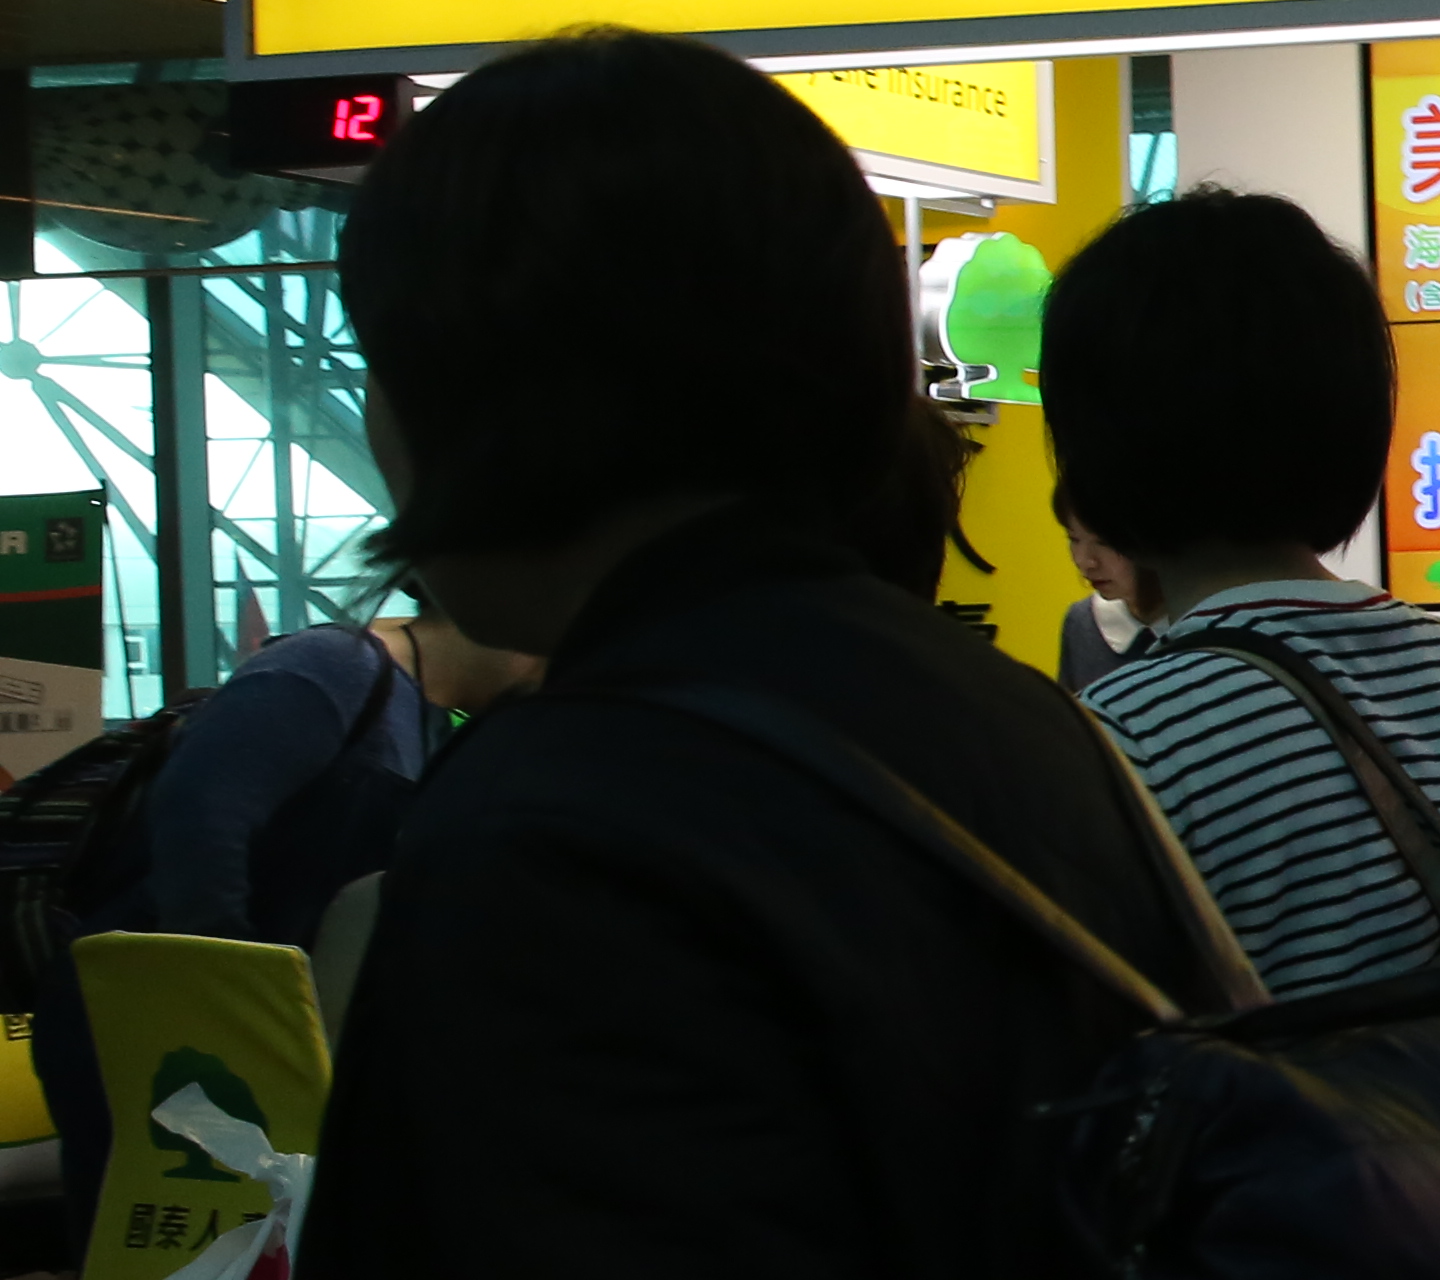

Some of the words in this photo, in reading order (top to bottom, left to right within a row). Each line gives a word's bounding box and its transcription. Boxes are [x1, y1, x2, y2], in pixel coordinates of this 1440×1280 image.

[331, 93, 382, 141] 12
[125, 1202, 268, 1252] 國泰人
